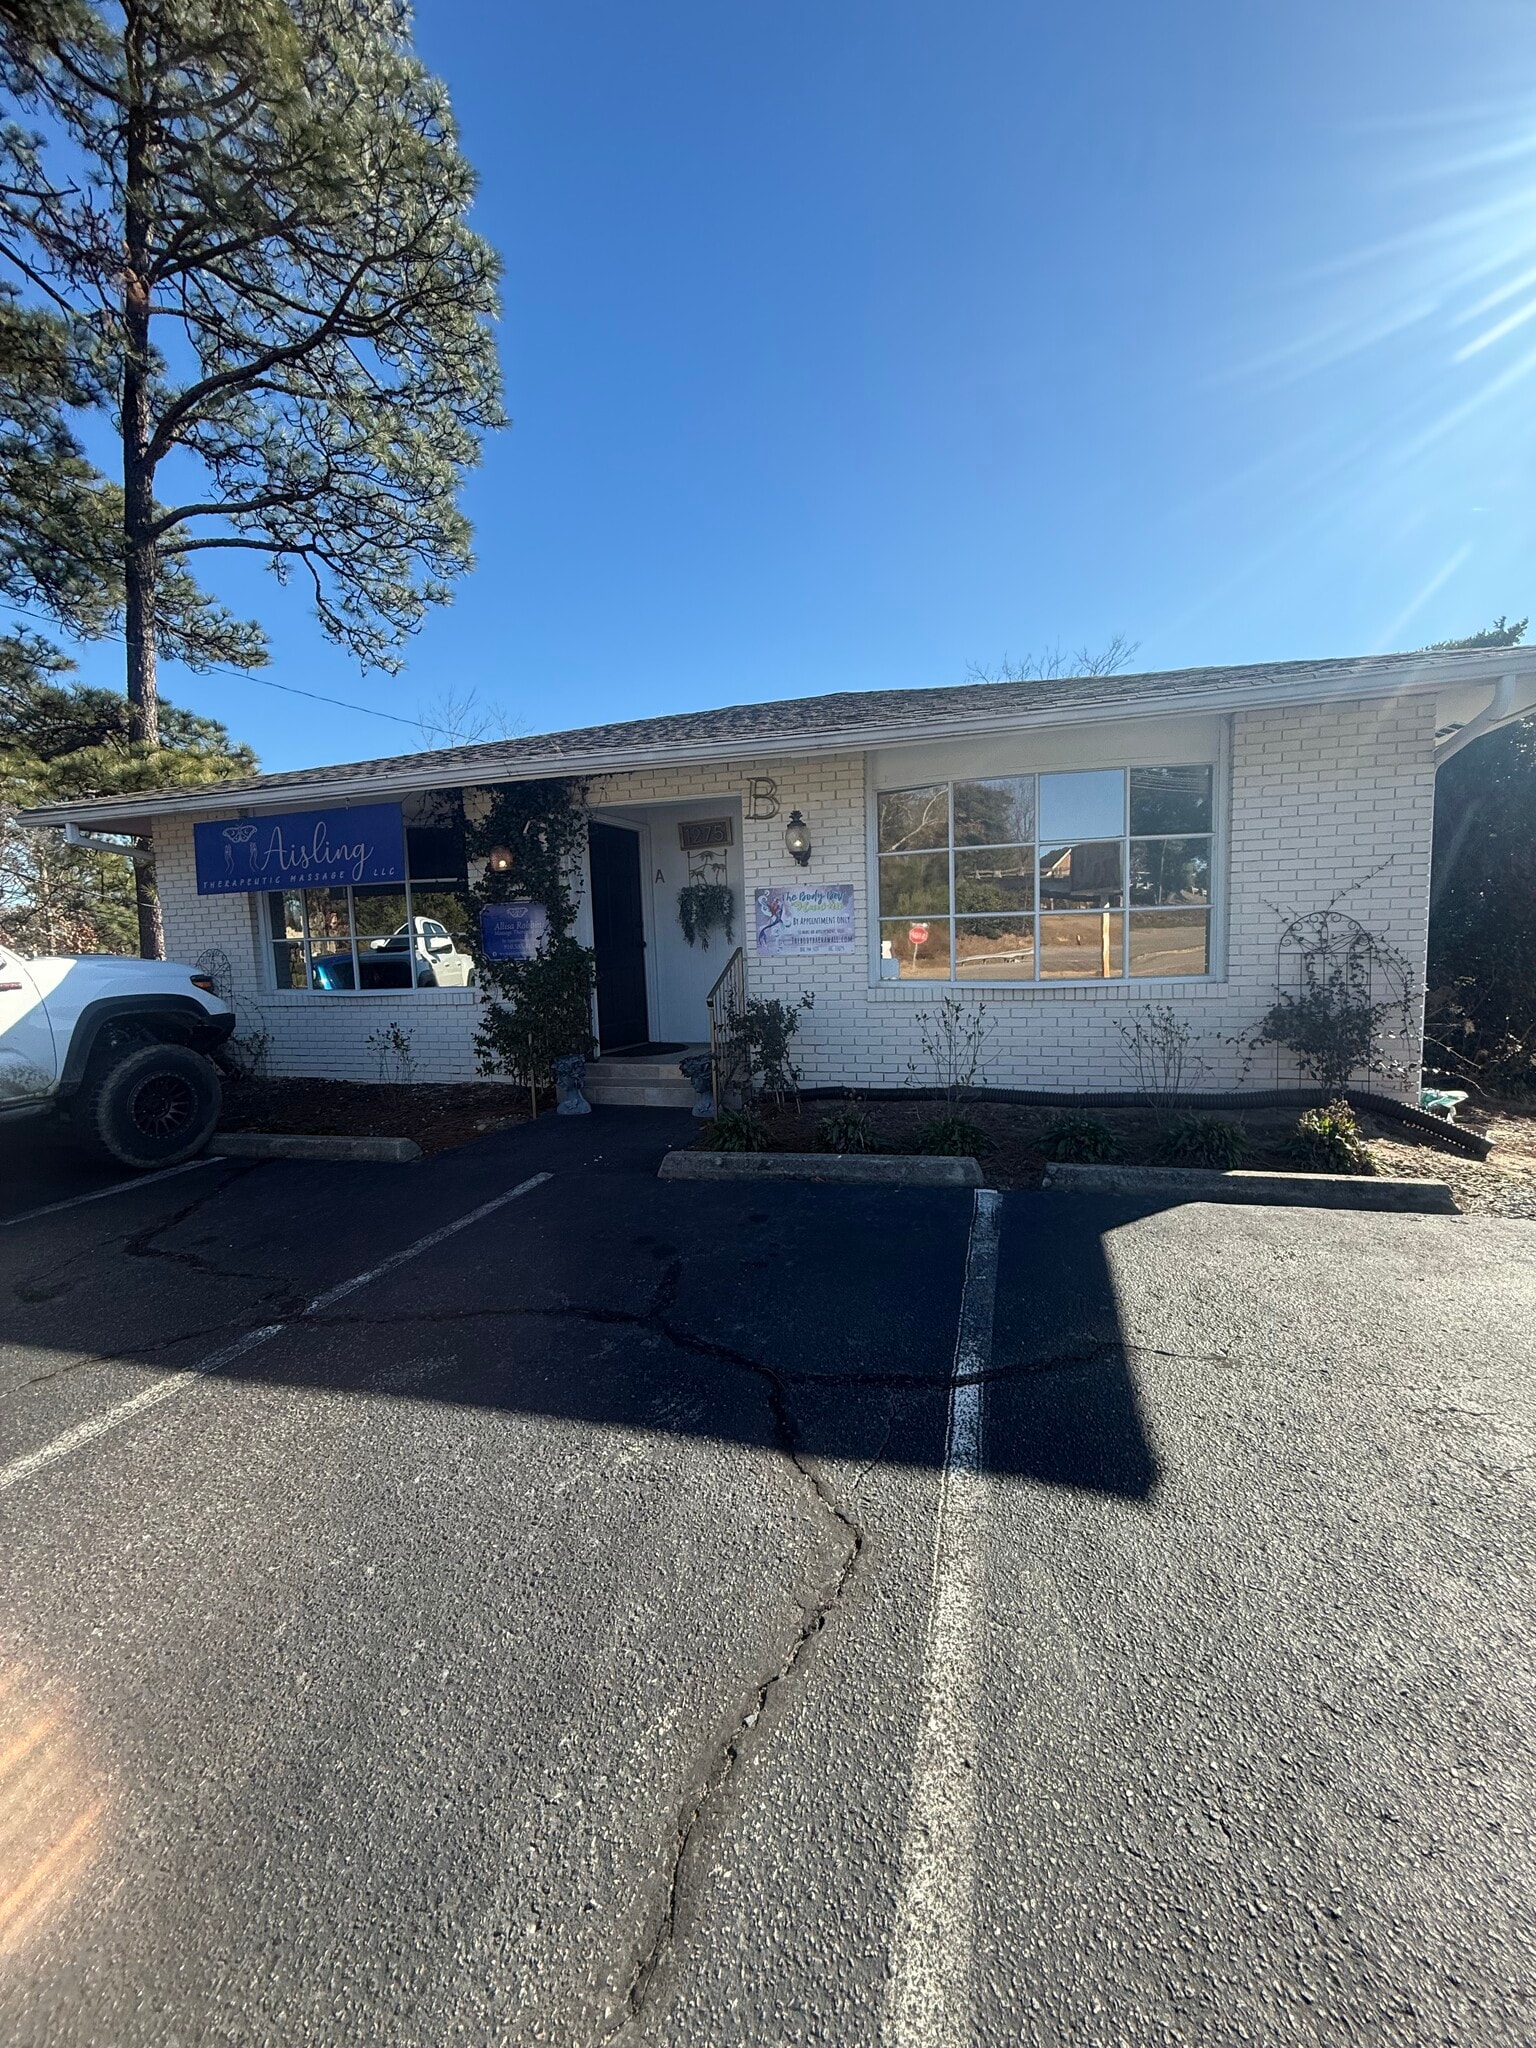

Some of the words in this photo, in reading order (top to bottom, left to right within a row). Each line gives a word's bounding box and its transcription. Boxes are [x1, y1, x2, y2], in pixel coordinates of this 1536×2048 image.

[745, 777, 780, 820] B
[685, 825, 725, 844] 1275
[260, 821, 374, 882] Aisling
[203, 875, 281, 889] THERAPEUTIC
[289, 870, 346, 883] MASSAGE
[373, 867, 395, 877] LLC
[655, 869, 665, 884] A
[799, 889, 826, 905] Body
[800, 916, 836, 925] APPOINTMENT
[836, 916, 850, 924] ONLY
